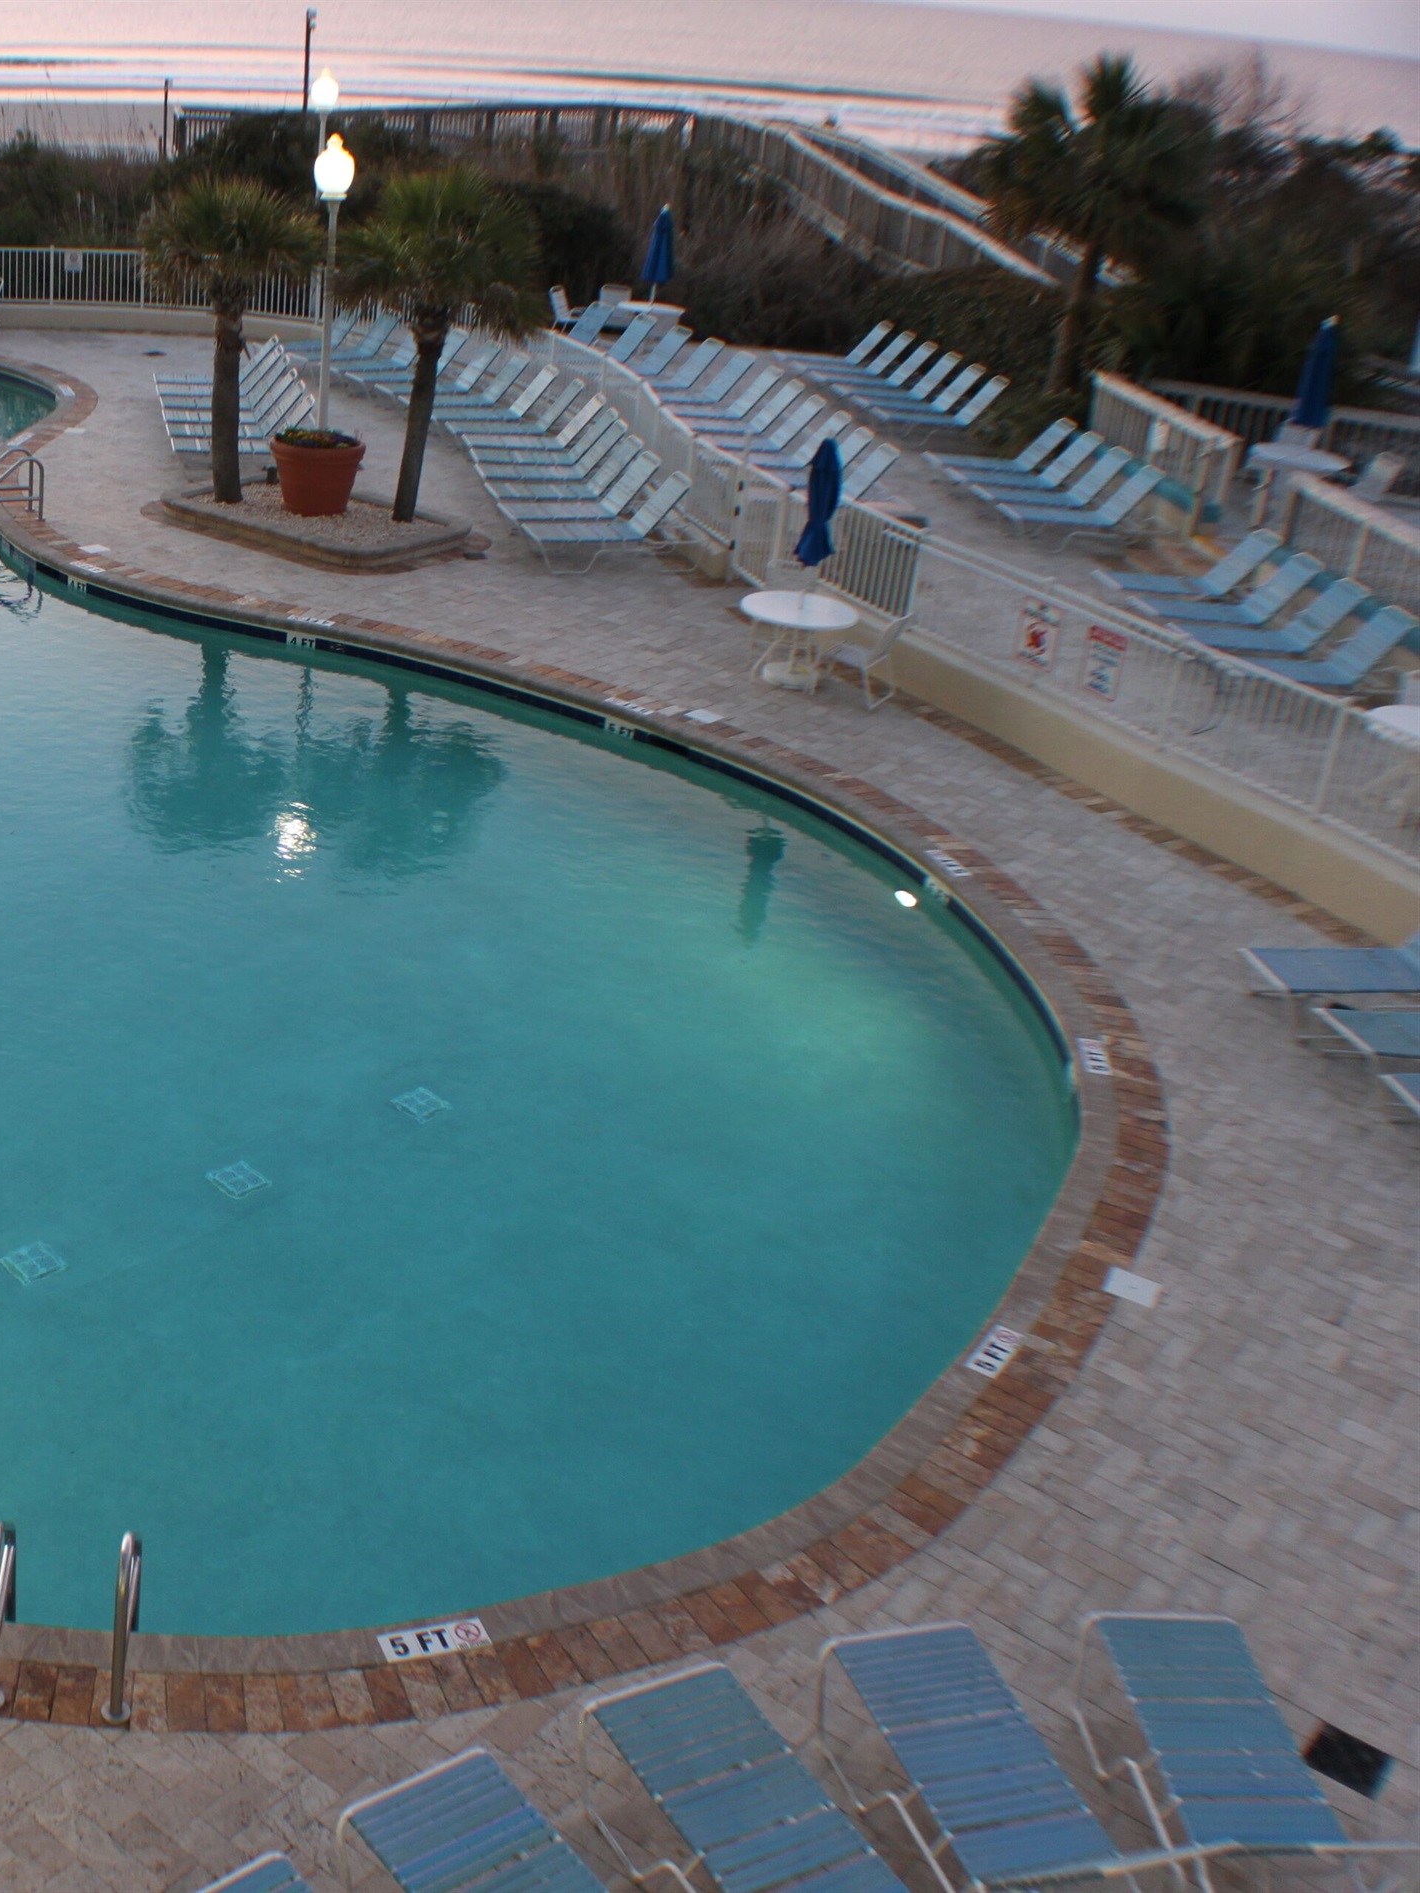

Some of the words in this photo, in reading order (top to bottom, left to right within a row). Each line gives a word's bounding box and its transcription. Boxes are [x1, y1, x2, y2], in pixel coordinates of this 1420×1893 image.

[290, 636, 297, 646] 4
[301, 637, 316, 648] FT
[983, 1342, 1011, 1362] FT
[973, 1359, 998, 1372] 5
[389, 1635, 411, 1657] 5
[415, 1628, 451, 1654] FT
